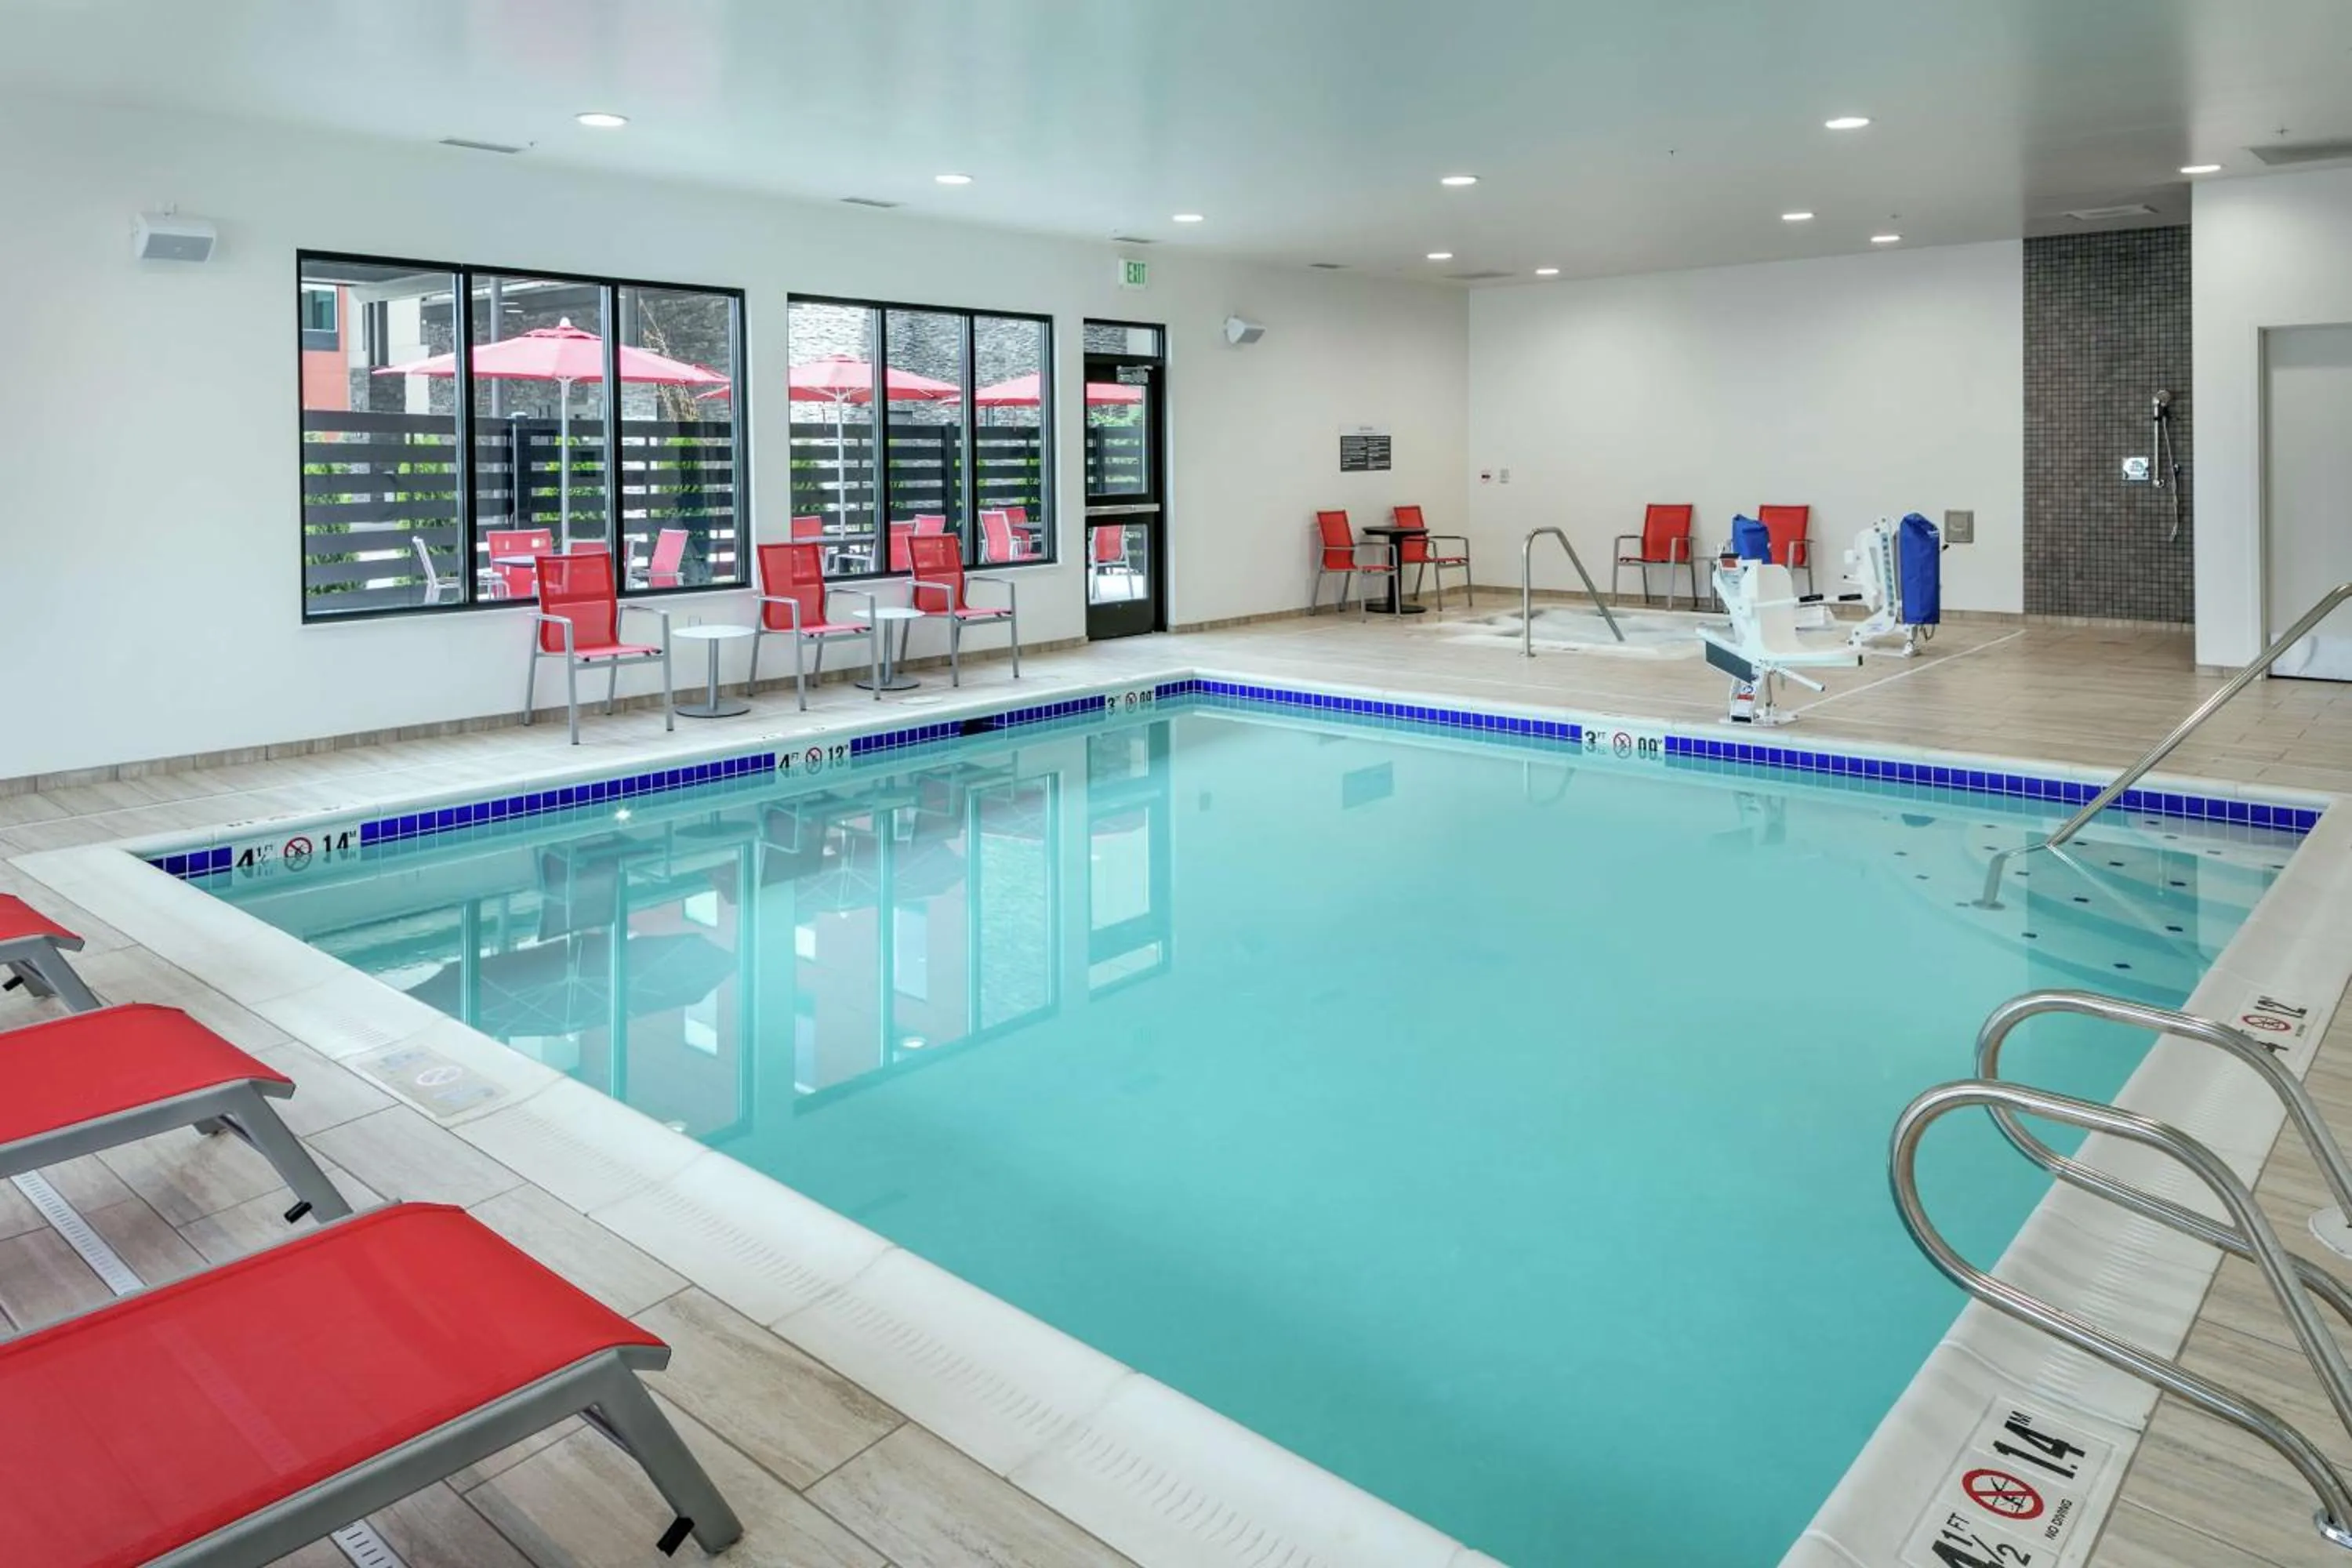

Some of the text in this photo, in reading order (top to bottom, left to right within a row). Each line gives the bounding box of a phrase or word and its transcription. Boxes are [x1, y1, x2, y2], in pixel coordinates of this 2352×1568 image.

[1127, 262, 1145, 285] EXIT
[2044, 1498, 2073, 1541] NO DIVING
